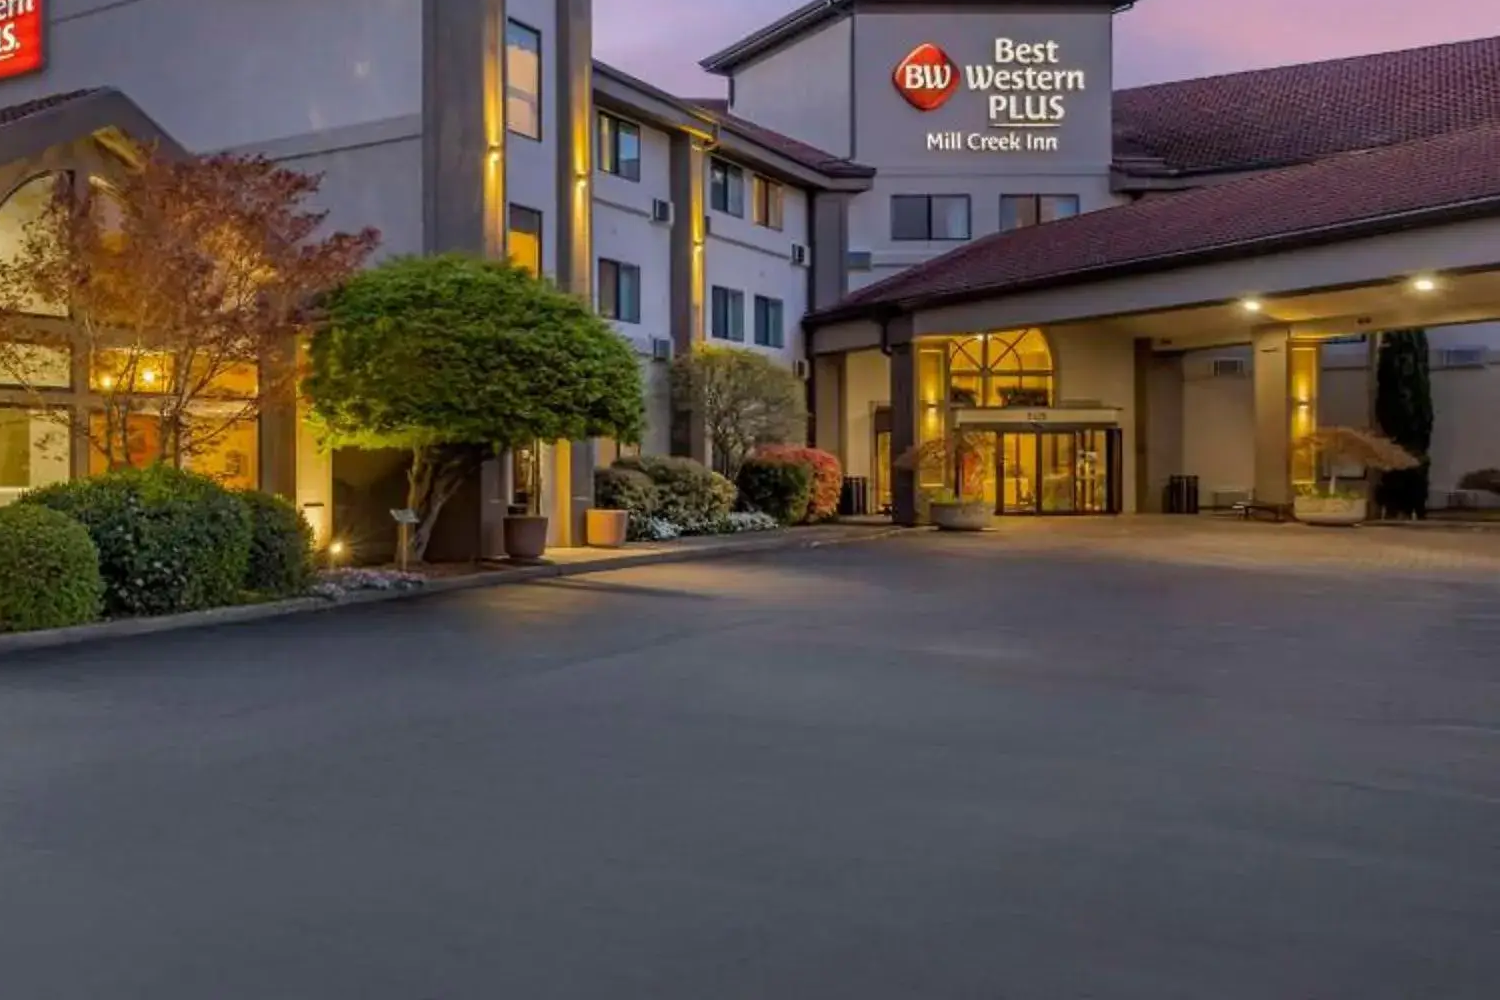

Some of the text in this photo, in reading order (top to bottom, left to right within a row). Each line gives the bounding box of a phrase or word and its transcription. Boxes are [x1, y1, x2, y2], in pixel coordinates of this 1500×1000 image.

[995, 37, 1060, 63] Best
[905, 64, 951, 89] BW
[965, 65, 1085, 90] Western
[989, 95, 1066, 120] PLUS
[926, 132, 1058, 151] Mill Creek Inn
